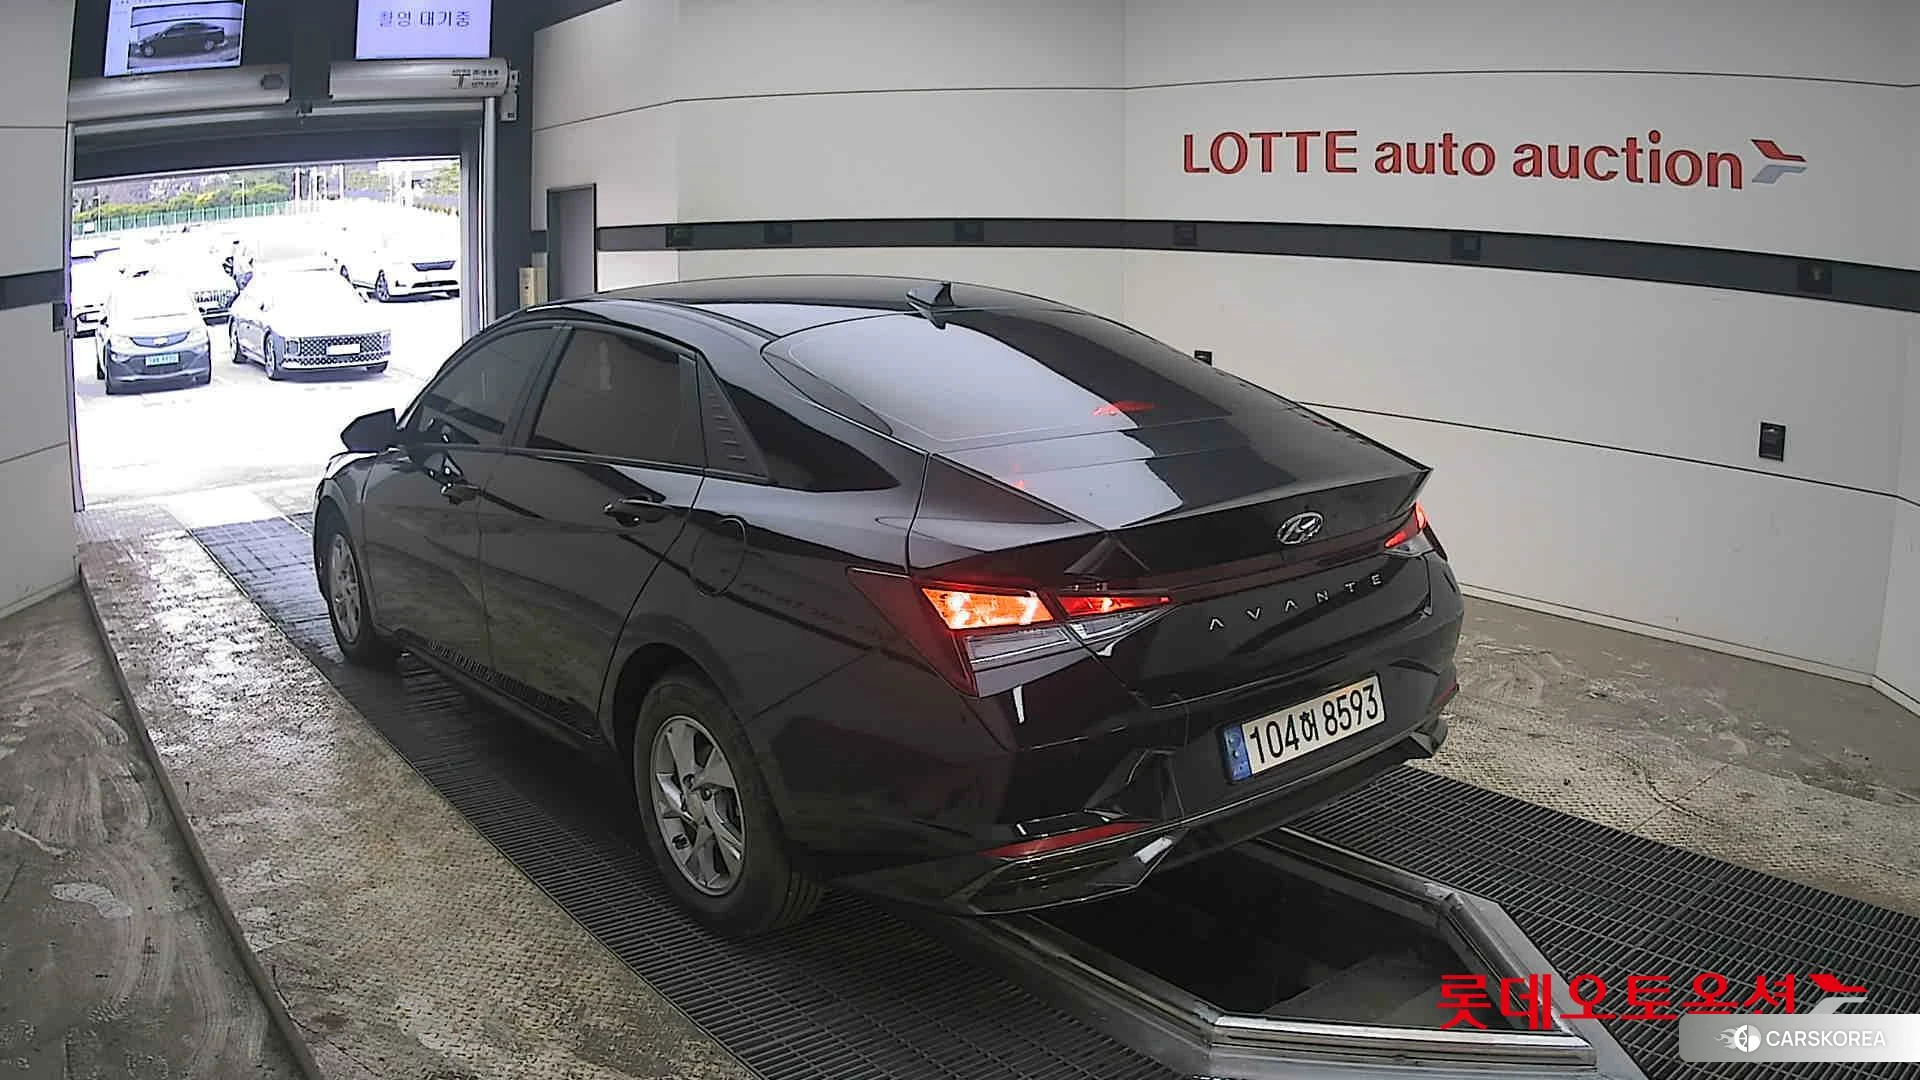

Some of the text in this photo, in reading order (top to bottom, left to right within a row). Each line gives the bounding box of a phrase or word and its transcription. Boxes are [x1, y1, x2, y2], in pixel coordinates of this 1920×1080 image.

[420, 10, 470, 28] 대기중
[1183, 129, 1744, 189] LOTTE auto auction
[1208, 573, 1383, 631] AVANTE
[1248, 683, 1379, 764] 104허 8593
